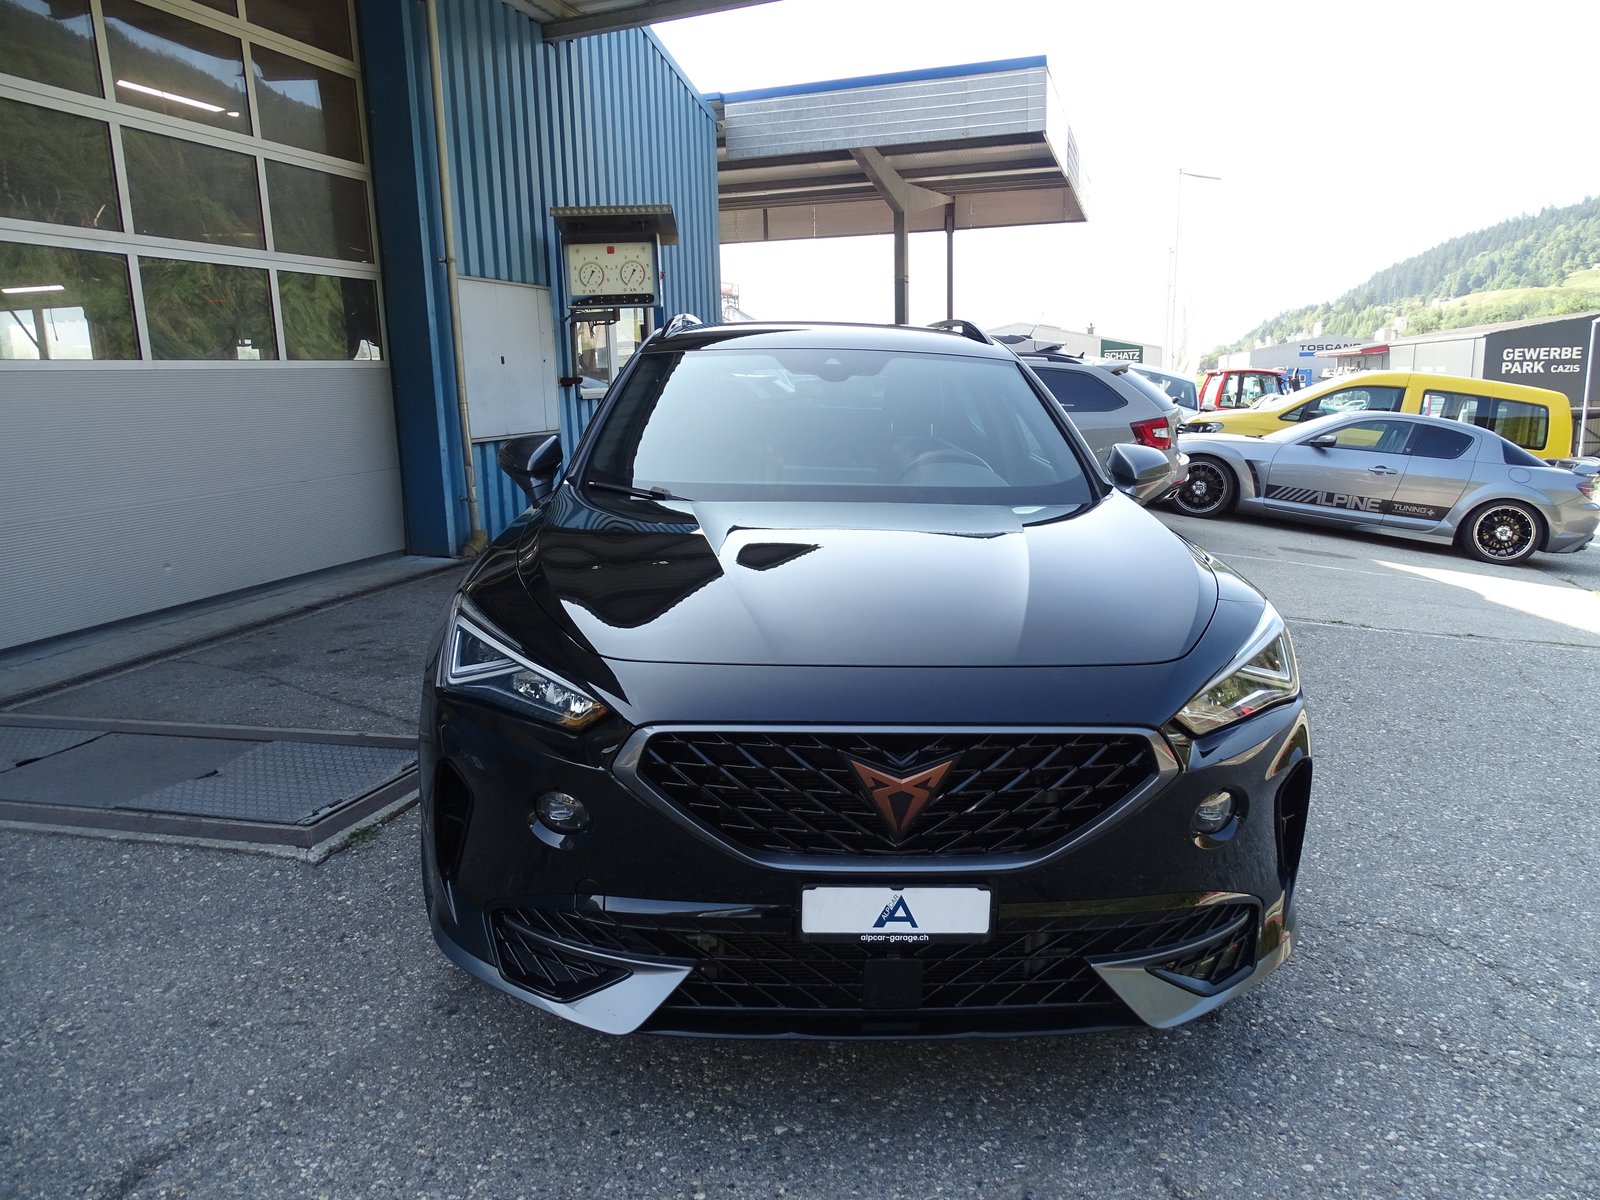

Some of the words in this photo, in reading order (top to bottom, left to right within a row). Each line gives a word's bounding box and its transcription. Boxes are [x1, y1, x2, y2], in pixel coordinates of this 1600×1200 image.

[1104, 351, 1140, 360] SCHATZ
[1502, 347, 1583, 361] GEWERBE
[1501, 361, 1545, 374] PARK
[1550, 364, 1580, 373] CAZIS
[1304, 491, 1382, 512] ALPINE
[1393, 503, 1427, 514] TUNING
[860, 934, 929, 942] alpcar-garage.ch
